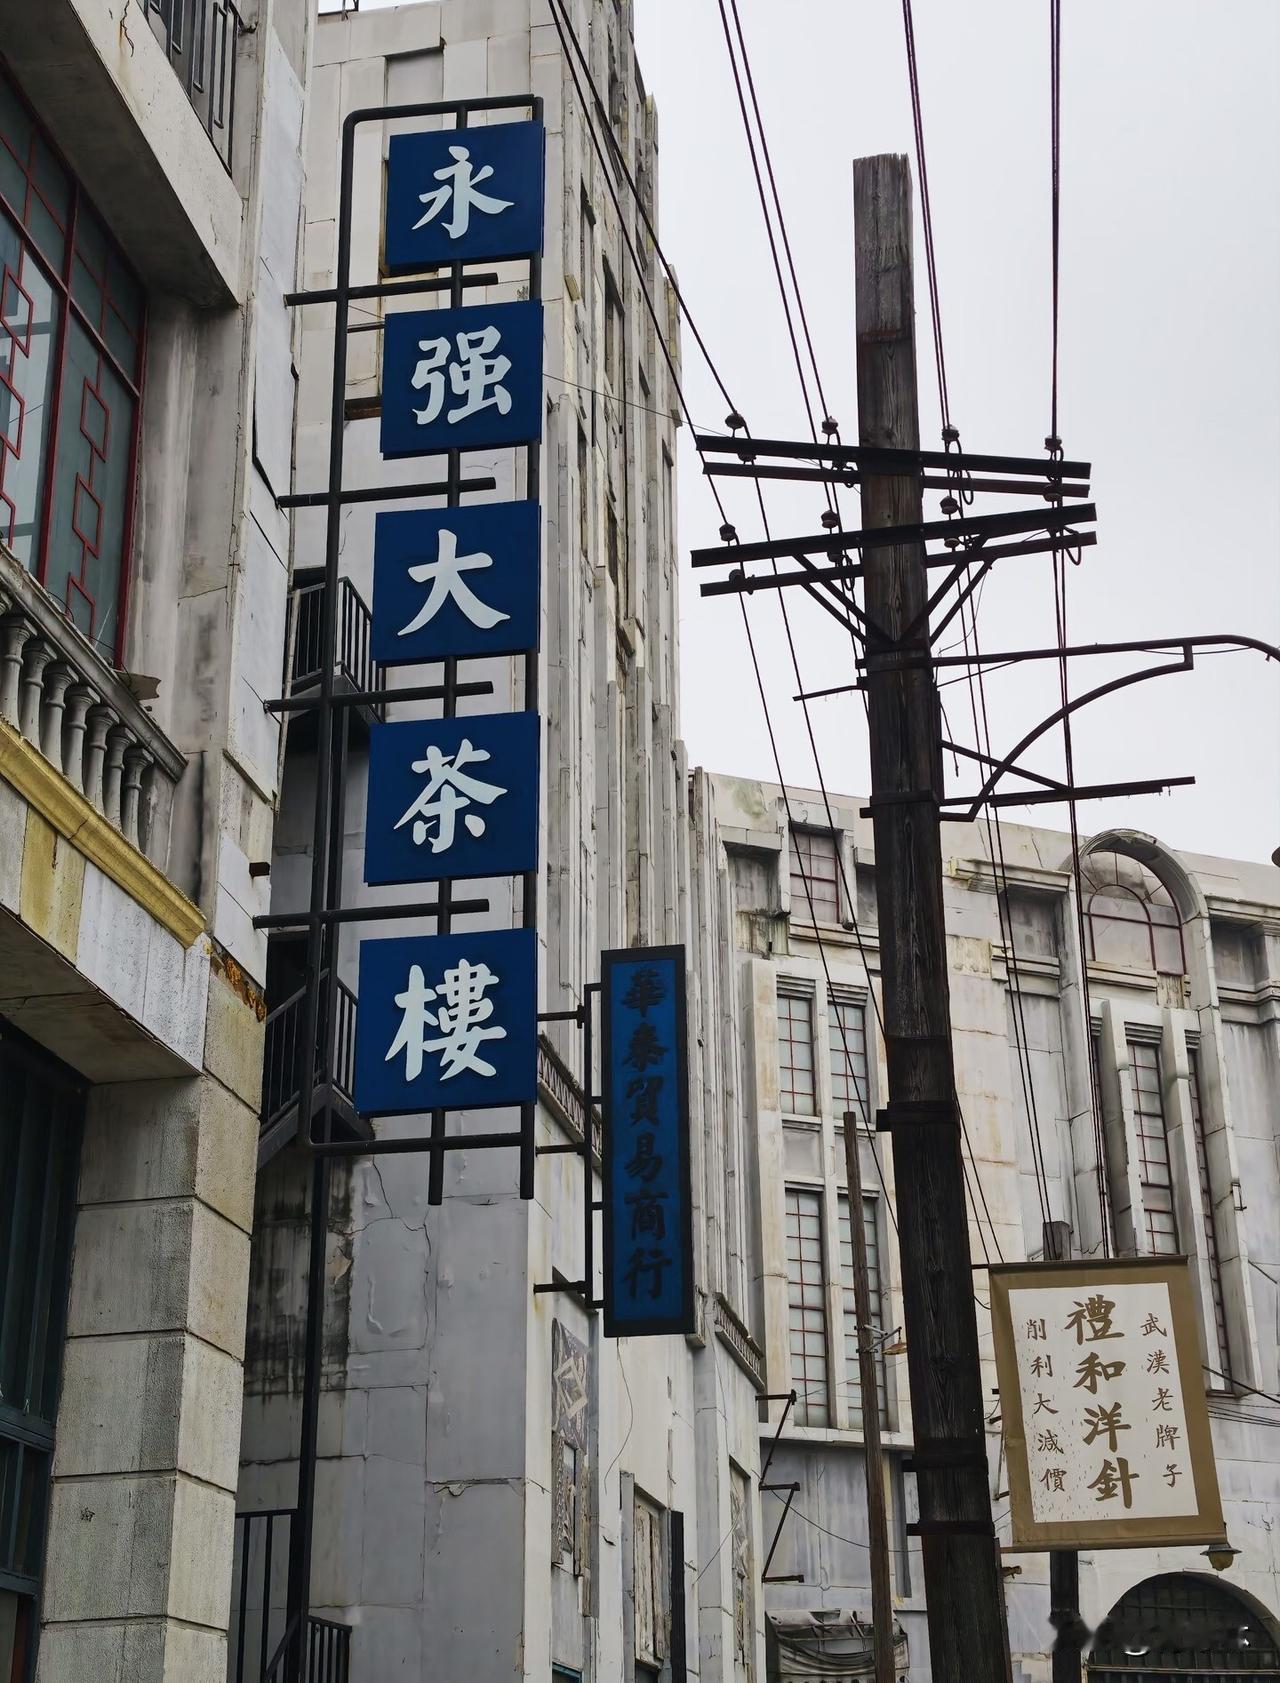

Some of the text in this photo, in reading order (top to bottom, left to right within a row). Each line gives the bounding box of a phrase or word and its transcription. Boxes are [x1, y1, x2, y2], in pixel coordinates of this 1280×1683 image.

[385, 145, 515, 1082] 永强大茶樓
[1025, 1318, 1067, 1493] 削利大減價
[1064, 1294, 1139, 1509] 禮和洋針
[1140, 1312, 1183, 1488] 武漢老牌子
